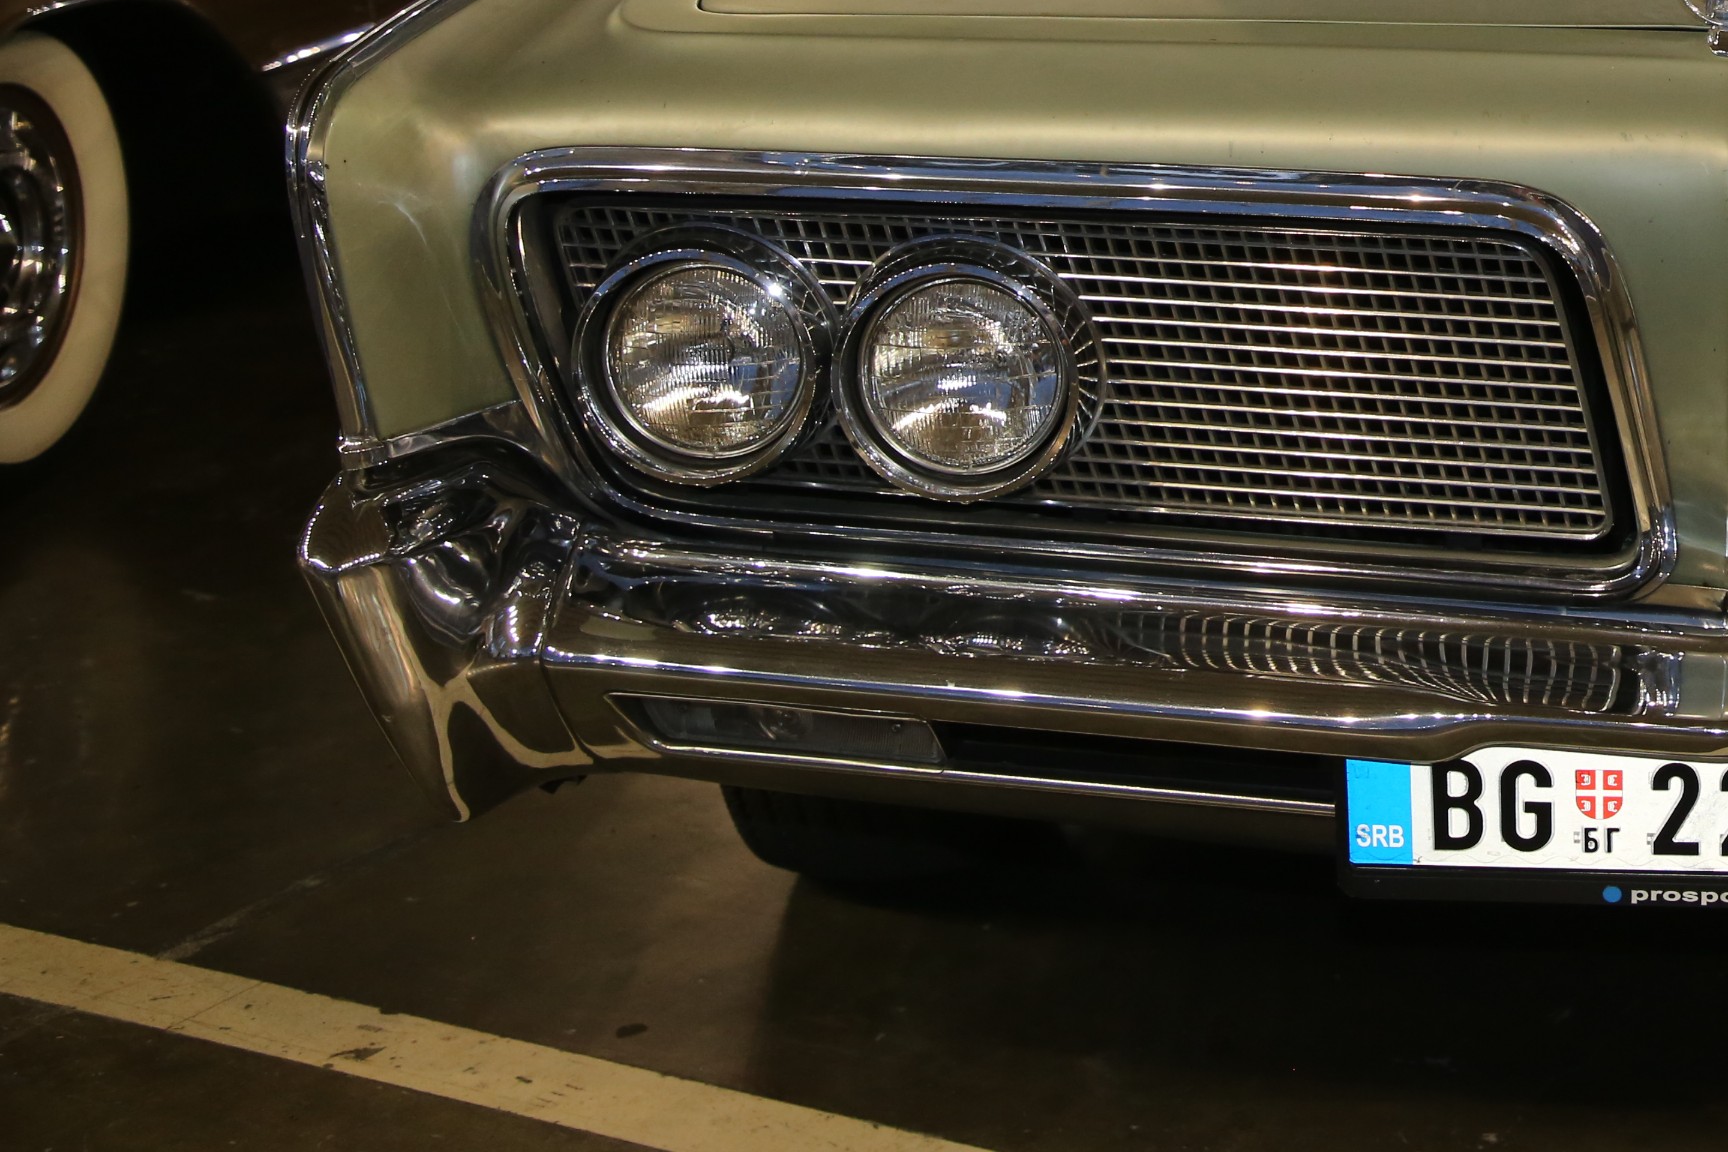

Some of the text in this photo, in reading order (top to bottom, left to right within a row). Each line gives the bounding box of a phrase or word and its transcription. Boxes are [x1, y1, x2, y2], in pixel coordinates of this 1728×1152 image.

[1431, 759, 1555, 852] BG
[1355, 823, 1405, 848] SRB
[1582, 827, 1621, 854] БГ
